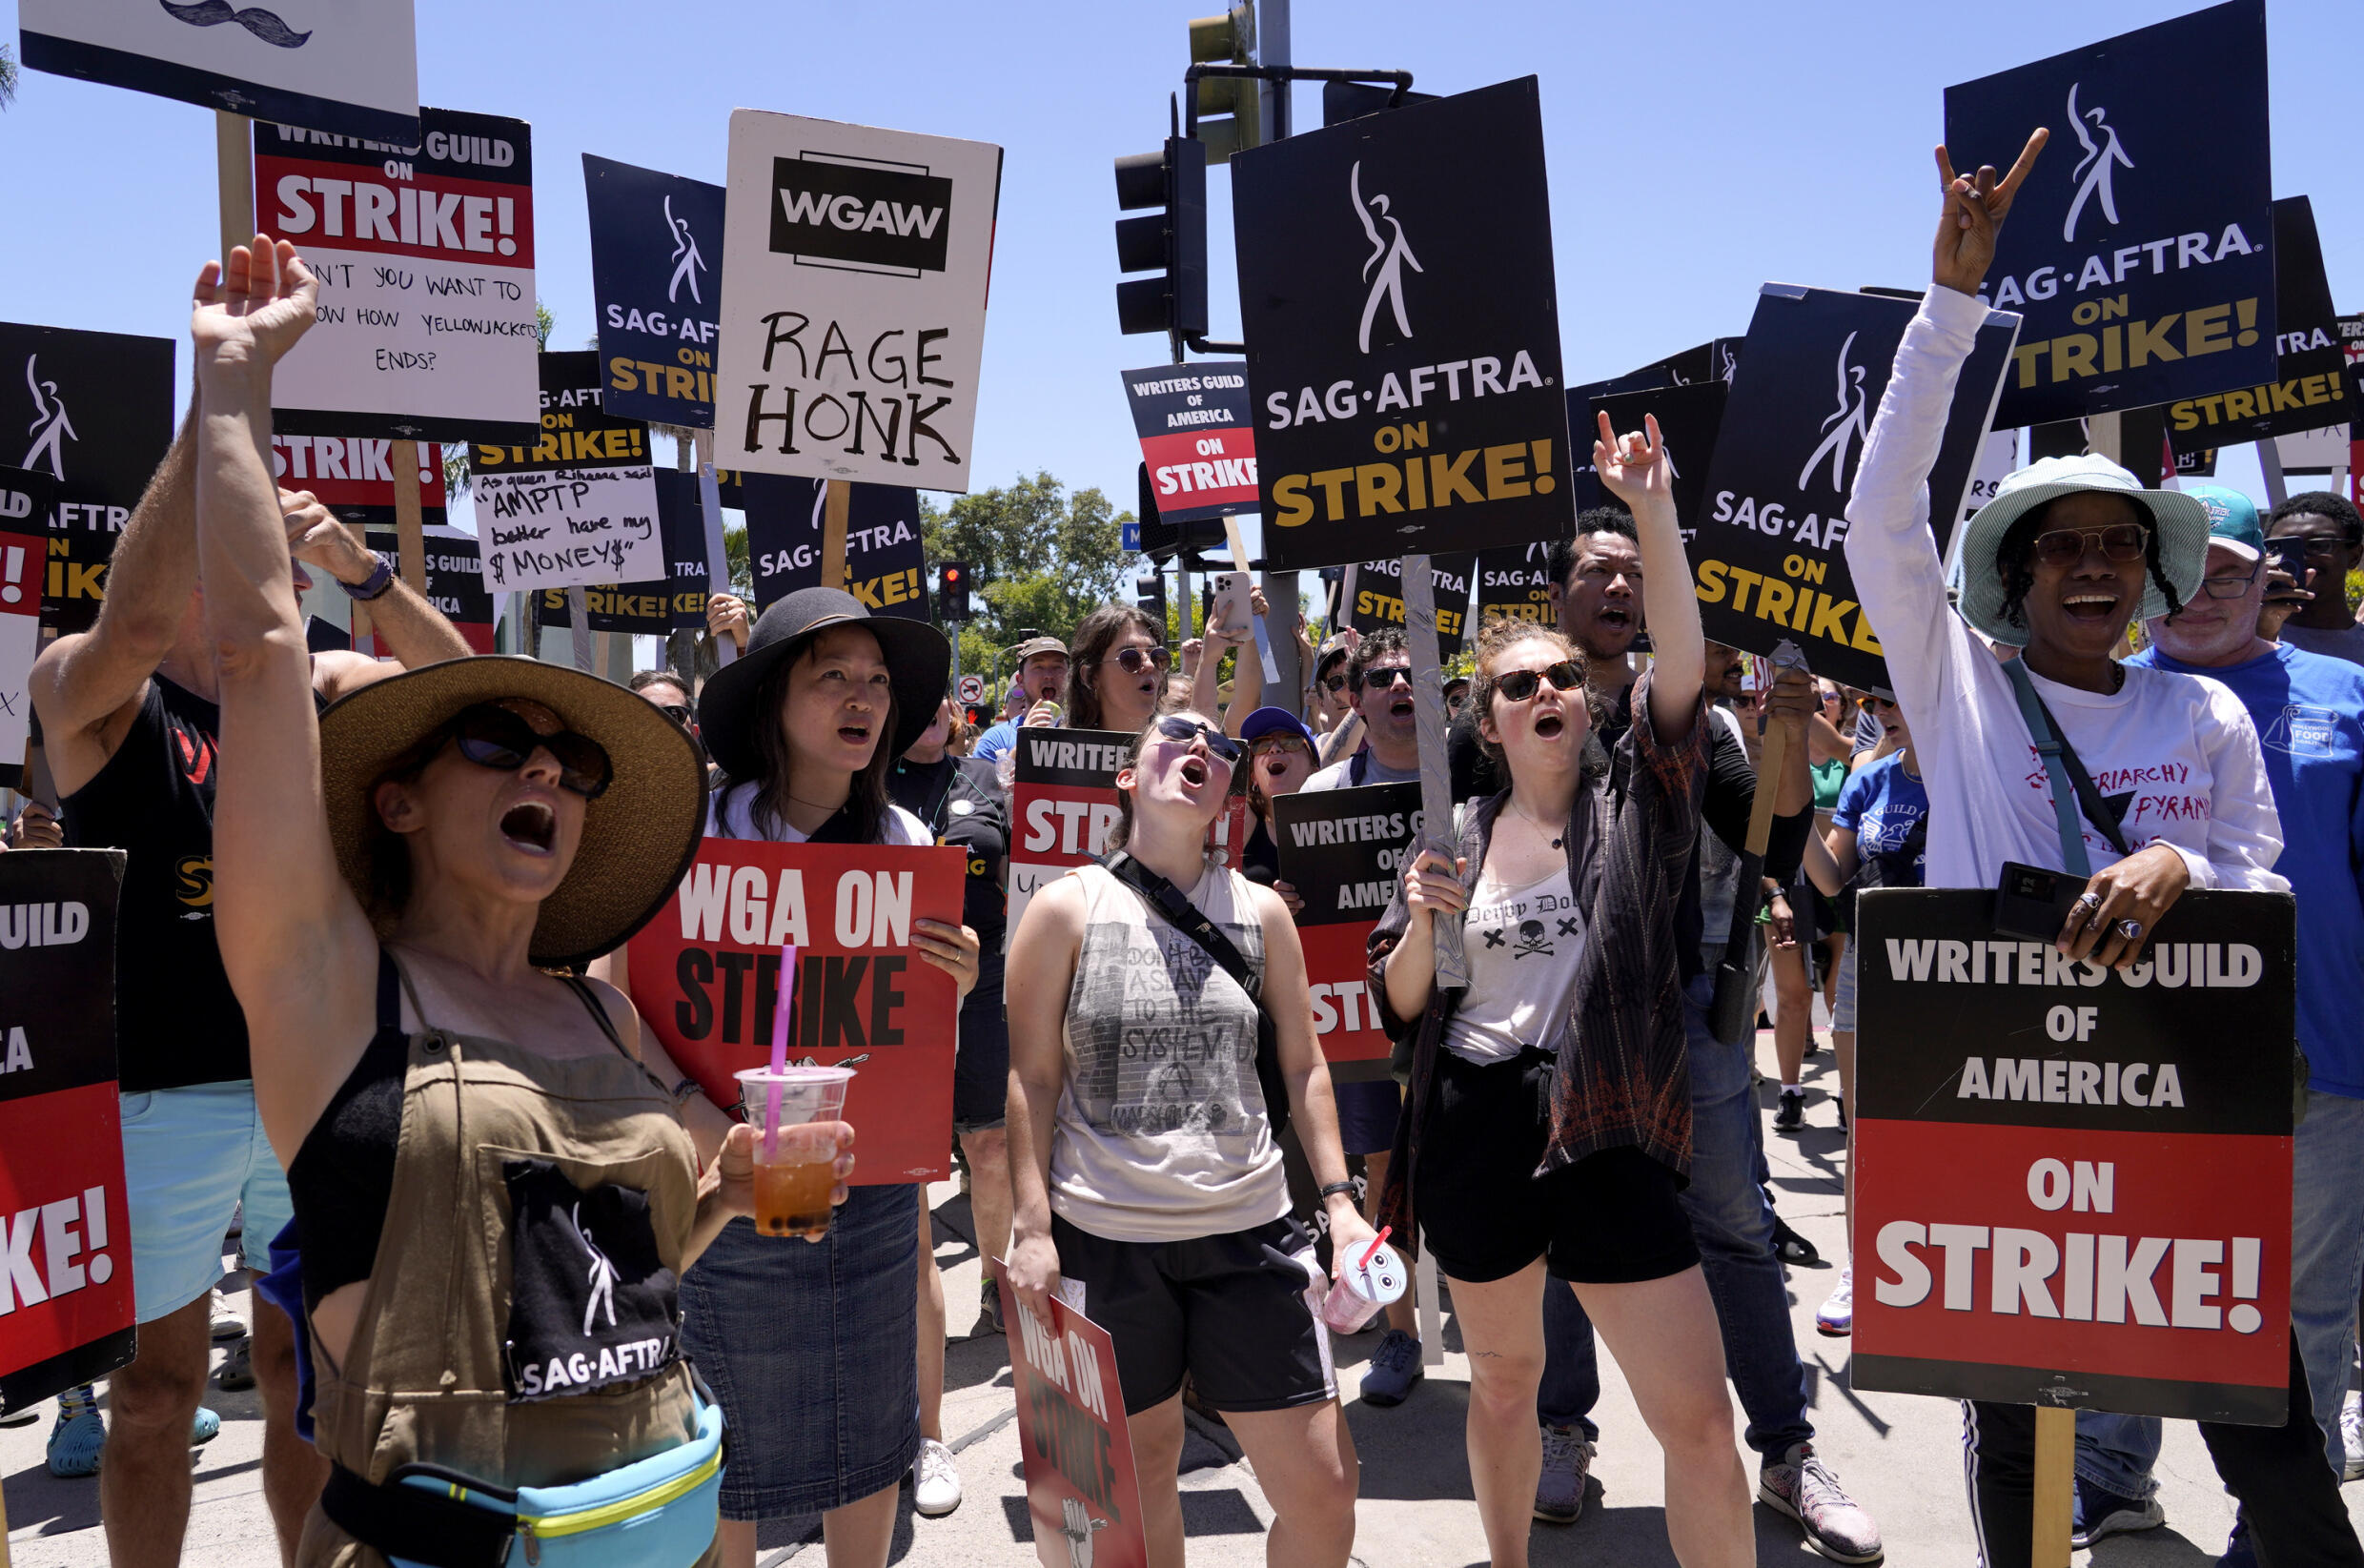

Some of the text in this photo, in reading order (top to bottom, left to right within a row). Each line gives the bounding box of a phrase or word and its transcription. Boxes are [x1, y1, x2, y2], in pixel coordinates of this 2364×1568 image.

[426, 131, 515, 168] GUILD
[384, 160, 413, 181] ON
[276, 174, 518, 256] STRIKE!
[779, 188, 943, 239] WGAW
[374, 267, 413, 290] YOU
[426, 275, 485, 297] WANT
[493, 280, 520, 300] TO
[315, 306, 345, 324] OW
[357, 308, 399, 327] HOW
[2071, 294, 2129, 326] ON
[376, 349, 437, 371] ENDS?
[678, 348, 711, 368] ON
[761, 311, 954, 389] RAGE
[2010, 297, 2259, 389] TRIKE!
[610, 356, 717, 404] STRI
[1133, 376, 1245, 397] WRITERS GUILD
[1168, 409, 1234, 427] AMERICA
[1187, 395, 1203, 406] OF
[2170, 372, 2344, 431] STRIKE!
[540, 414, 574, 429] ON
[744, 384, 961, 465] HONK
[1374, 420, 1429, 454] ON
[272, 435, 434, 484] STRIK!
[1196, 438, 1224, 456] ON
[1156, 458, 1258, 495] STRIKE
[1272, 438, 1556, 527] STRIKE!
[491, 517, 652, 546] better have my
[1783, 555, 1827, 585] ON
[544, 588, 667, 619] SRIKE!
[2295, 730, 2330, 742] FOOD
[1874, 804, 1918, 816] GUILD
[1290, 811, 1406, 847] WRITERS
[679, 863, 913, 947] WGA ON
[0, 902, 90, 949] UILD
[1885, 939, 2108, 988] WRITERS
[675, 947, 907, 1048] STRIKE
[2046, 1006, 2097, 1042] OF
[1957, 1057, 2185, 1108] AMERICA
[2027, 1158, 2114, 1213] ON
[1876, 1220, 2263, 1334] STRIKE!
[1069, 1330, 1108, 1423] ON
[1029, 1372, 1121, 1524] STRIKE
